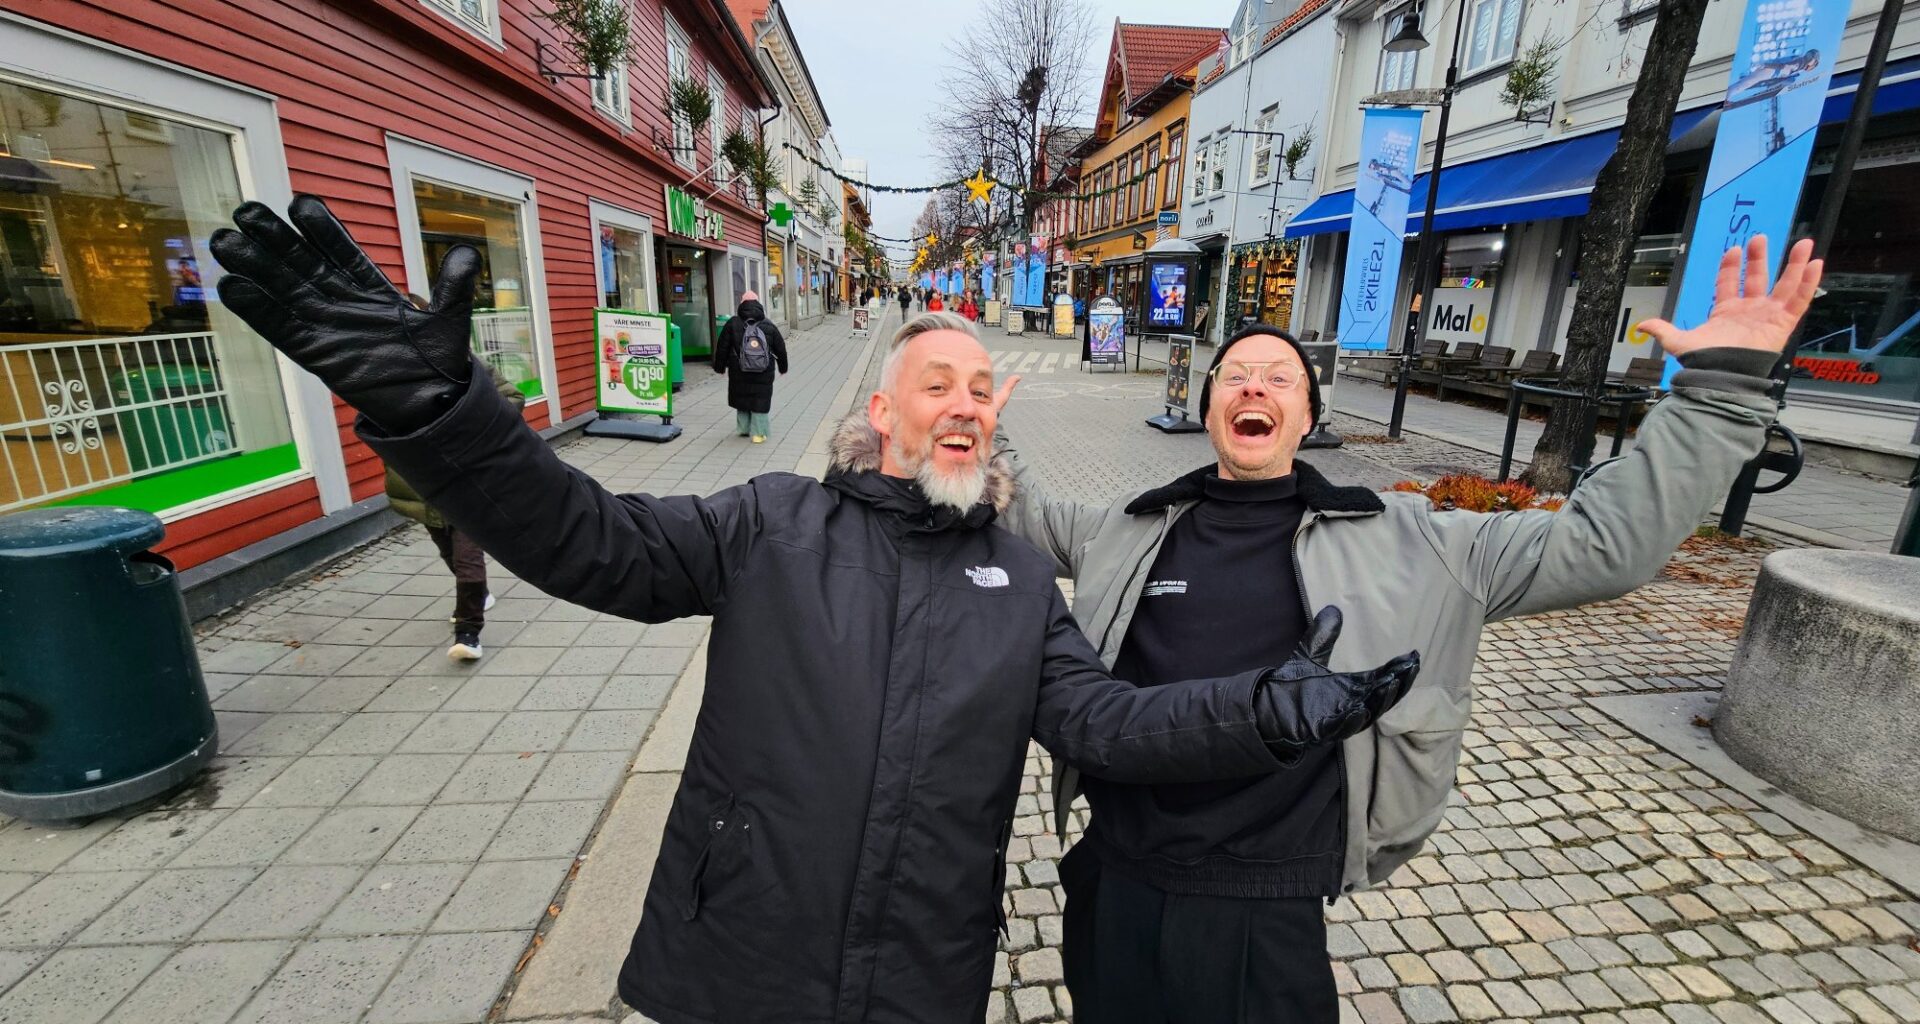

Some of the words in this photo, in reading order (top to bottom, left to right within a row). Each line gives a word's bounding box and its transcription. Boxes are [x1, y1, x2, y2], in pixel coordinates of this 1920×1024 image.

[1160, 214, 1177, 222] norli
[1432, 304, 1487, 333] Malo
[1792, 357, 1859, 371] KAJAKK
[1814, 368, 1880, 384] FRITID
[965, 568, 993, 581] NORTH
[975, 566, 992, 575] THE
[972, 579, 993, 587] FACE
